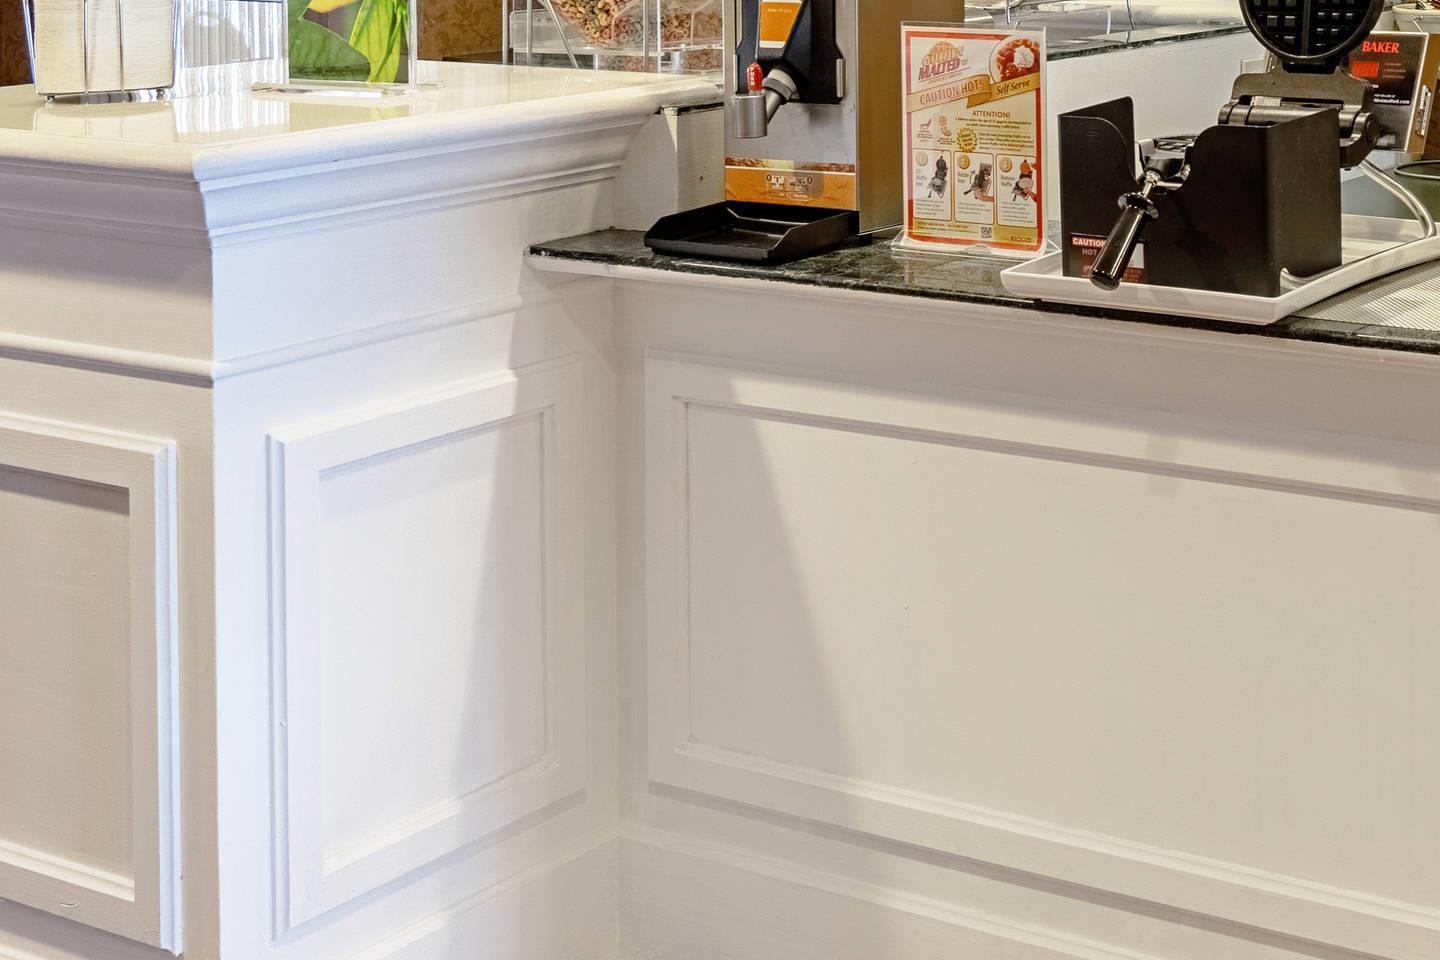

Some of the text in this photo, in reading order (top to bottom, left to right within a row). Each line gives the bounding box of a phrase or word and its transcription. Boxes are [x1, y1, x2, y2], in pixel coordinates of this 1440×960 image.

[1361, 40, 1400, 54] BAKER
[918, 57, 961, 81] MALTED
[919, 84, 960, 106] CAUTION
[961, 79, 984, 95] HOT!
[995, 79, 1031, 96] Self Serve
[971, 110, 1011, 118] ATTENTION!
[1072, 237, 1108, 248] CAUTION
[1082, 247, 1098, 256] HOT
